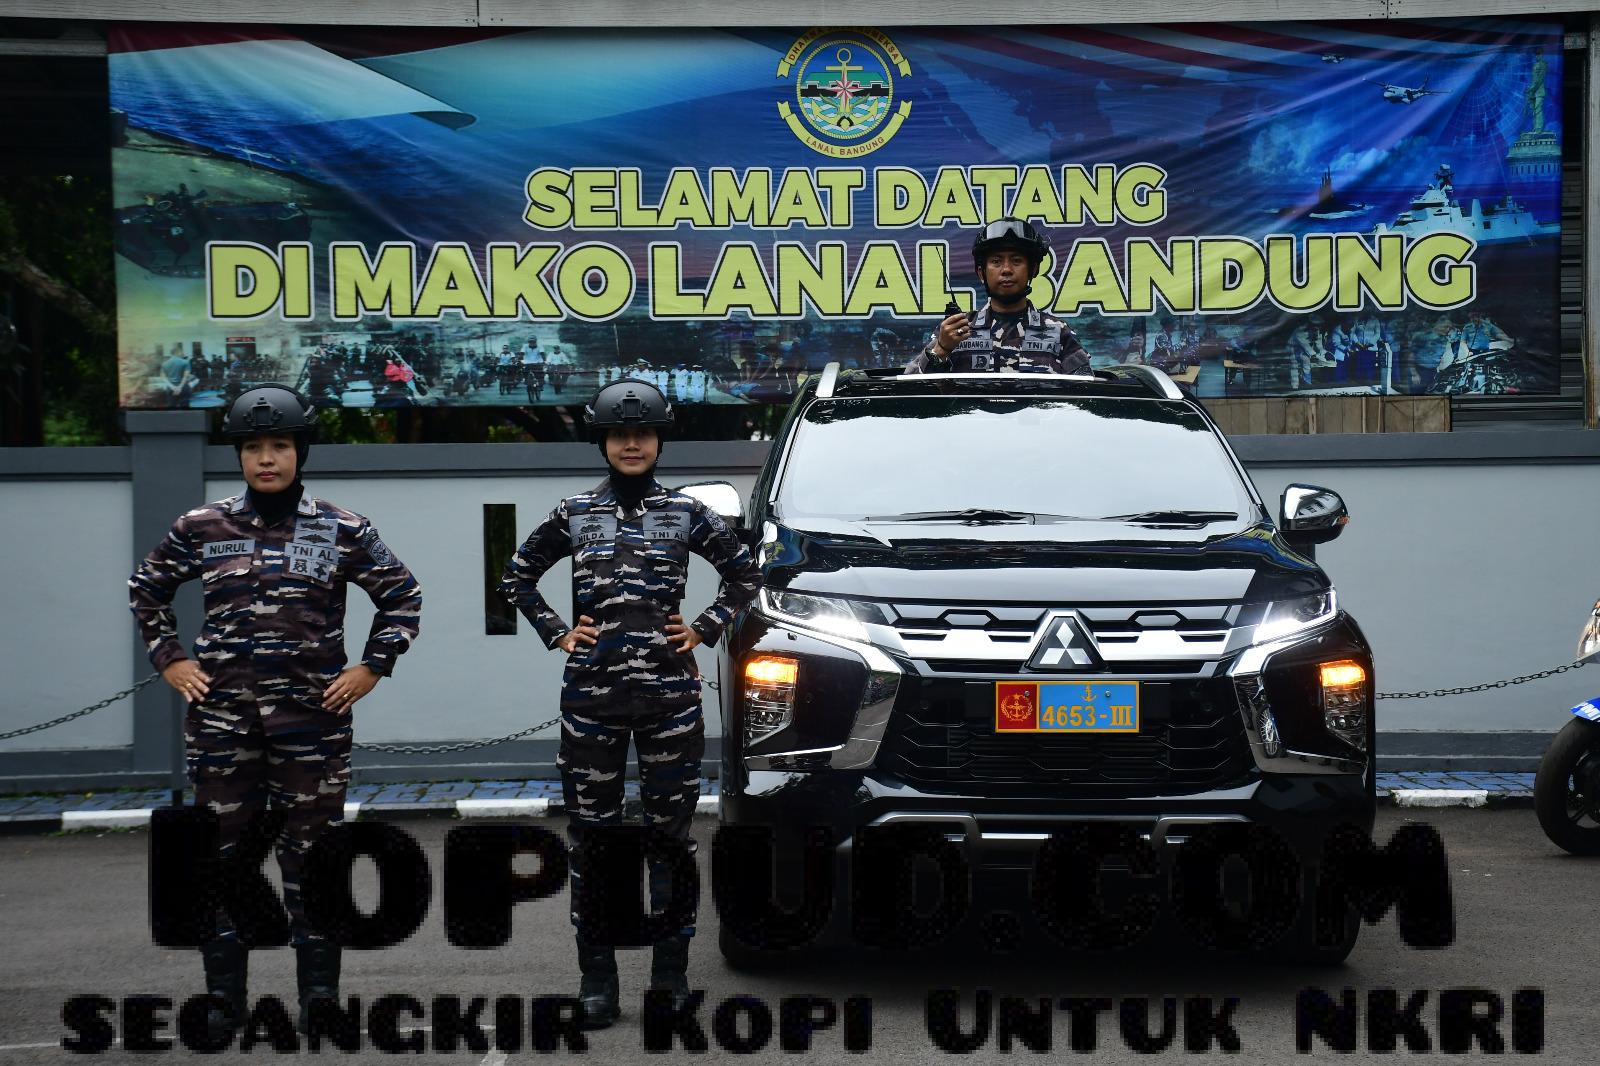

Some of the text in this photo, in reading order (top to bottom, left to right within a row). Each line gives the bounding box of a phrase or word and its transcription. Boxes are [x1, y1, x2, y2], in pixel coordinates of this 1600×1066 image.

[805, 136, 885, 155] LANAL BANDUNG
[523, 162, 1168, 229] SELAMAT DATANG
[205, 240, 314, 322] DI
[329, 240, 636, 322] MAKO
[648, 239, 976, 321] LANAL
[1026, 341, 1043, 351] TNI
[651, 531, 685, 541] TNI AL
[209, 542, 248, 555] NURUL
[292, 545, 334, 562] TNI AL
[1041, 705, 1134, 727] 4653-III
